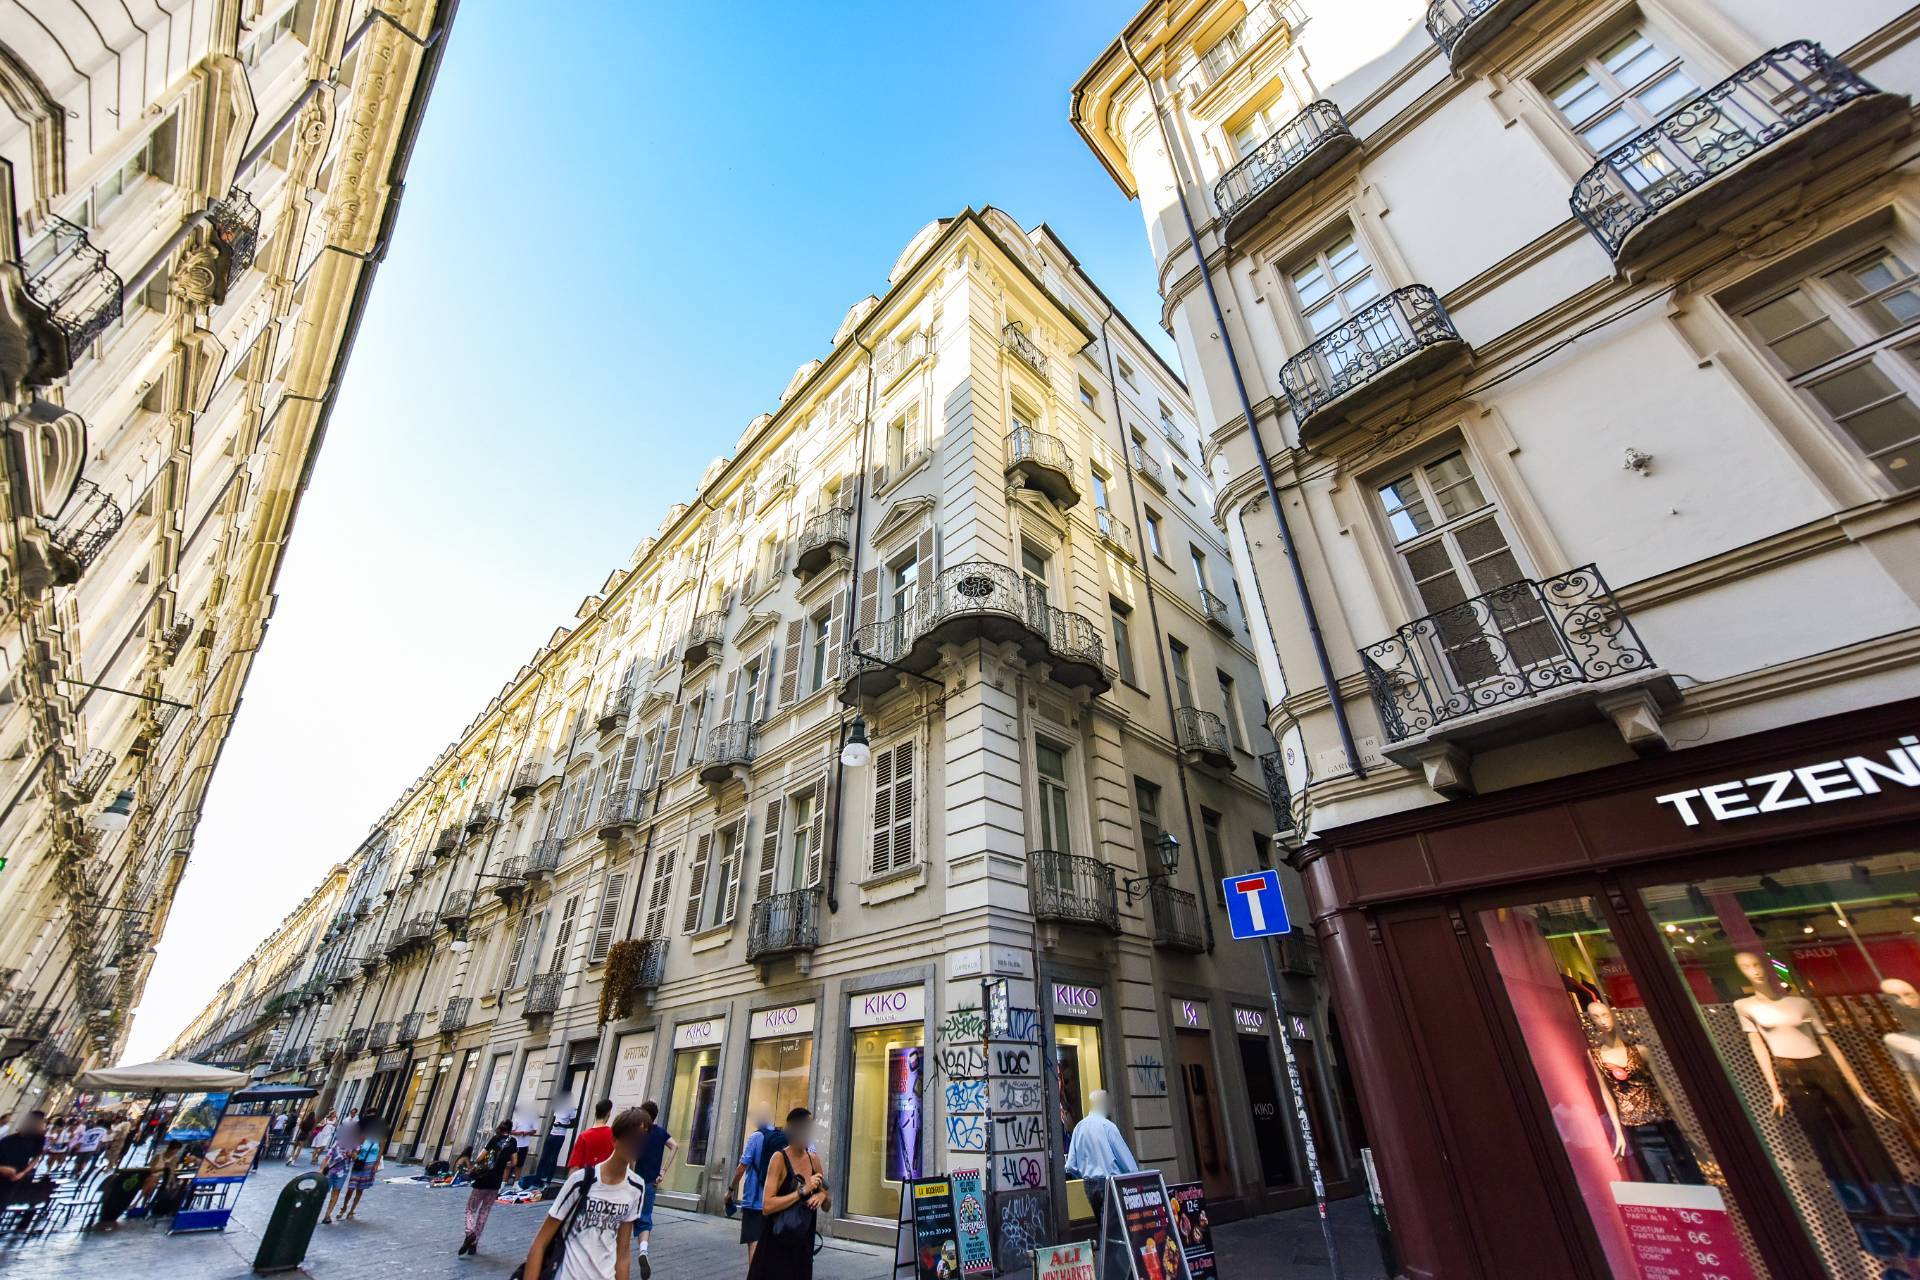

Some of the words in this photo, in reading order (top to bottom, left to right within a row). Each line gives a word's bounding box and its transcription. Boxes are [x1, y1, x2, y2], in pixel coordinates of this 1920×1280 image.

[1795, 946, 1838, 960] SALDI
[1054, 984, 1098, 1007] KIKO
[864, 992, 907, 1015] KIKO
[765, 1007, 798, 1027] KIKO
[1235, 1008, 1263, 1027] KIKO
[685, 1021, 712, 1039] KIKO
[1254, 1103, 1274, 1116] KIKO
[586, 1200, 629, 1216] BOXEUR
[1624, 1206, 1658, 1214] COSTUMI
[1650, 1214, 1668, 1222] ALTA
[1680, 1210, 1704, 1225] 9€
[1631, 1225, 1665, 1234] COSTUMI
[1687, 1231, 1712, 1245] 6€
[1050, 1247, 1081, 1267] ALI
[1637, 1245, 1672, 1255] COSTUMI
[1695, 1251, 1720, 1266] 9€
